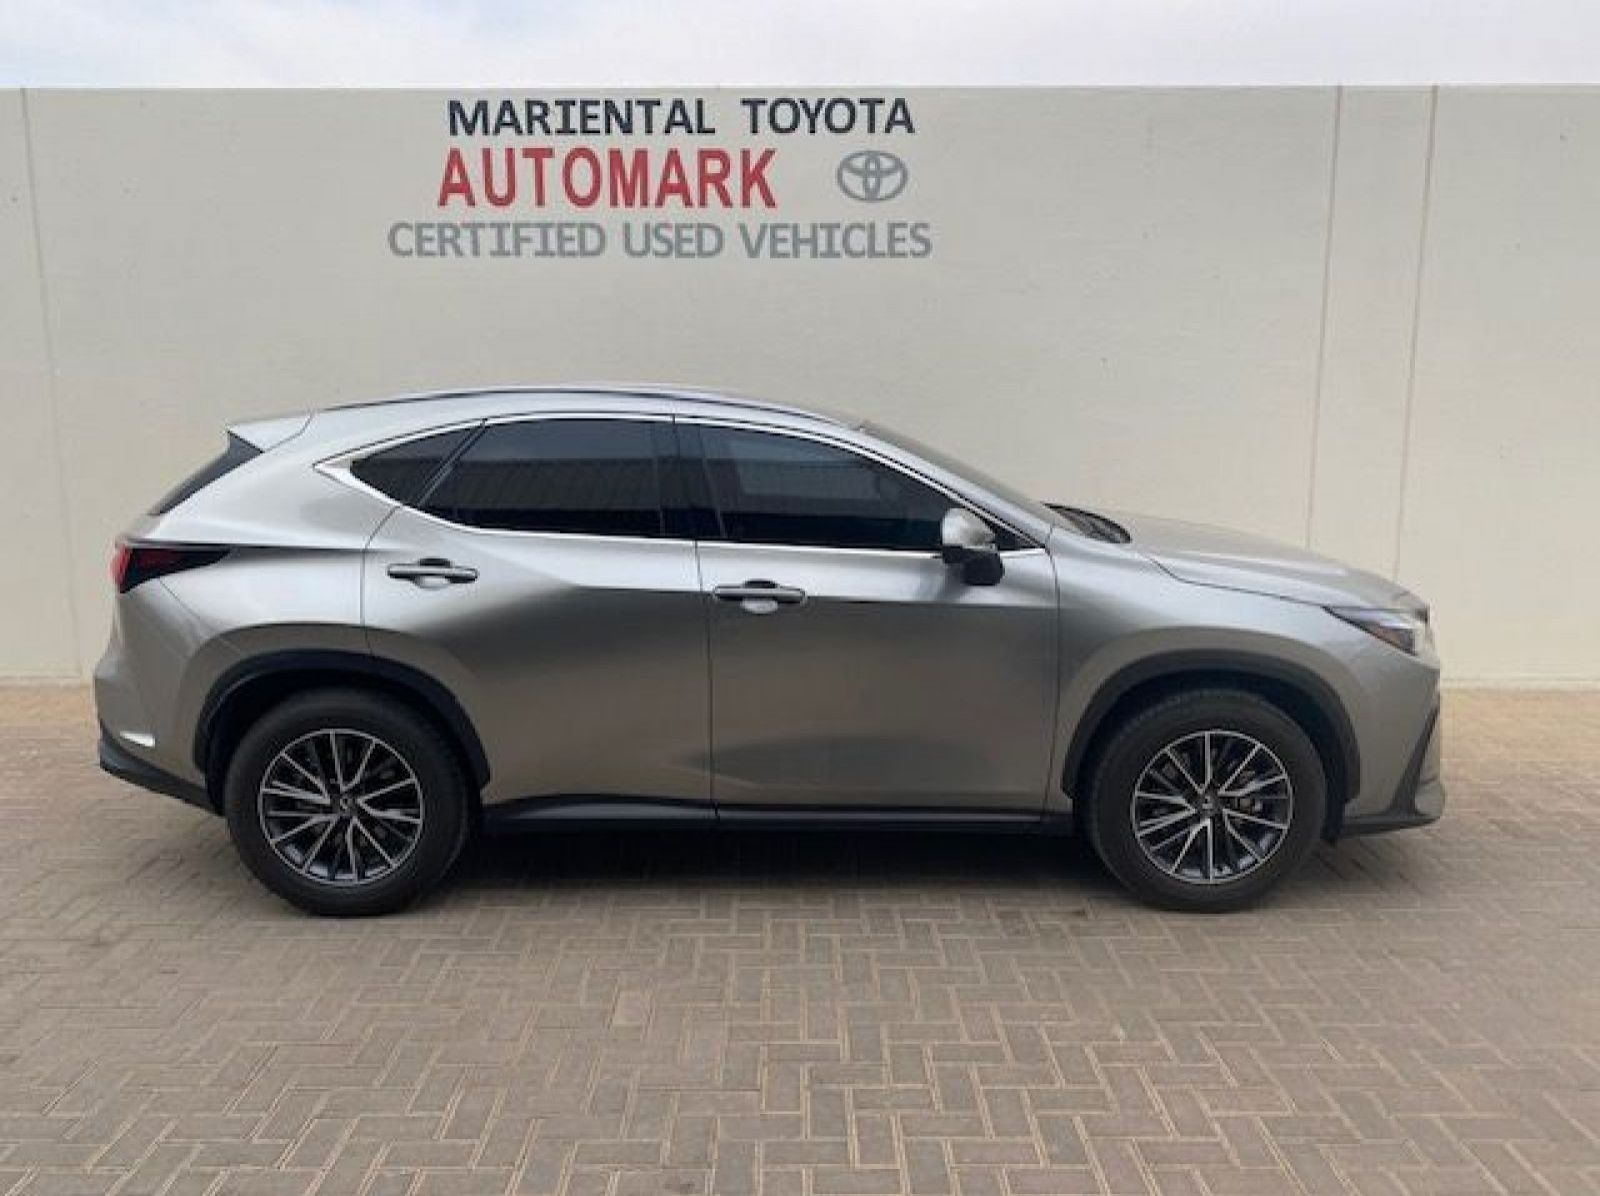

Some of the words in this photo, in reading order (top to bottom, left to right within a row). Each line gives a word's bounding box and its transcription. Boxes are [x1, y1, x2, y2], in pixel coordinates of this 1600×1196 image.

[448, 99, 716, 136] MARIENTAL
[741, 97, 915, 135] TOYOTA
[437, 147, 778, 209] AUTOMARK
[388, 222, 606, 258] CERTIFIED
[623, 222, 724, 258] USED
[739, 222, 932, 258] VEHICLES
